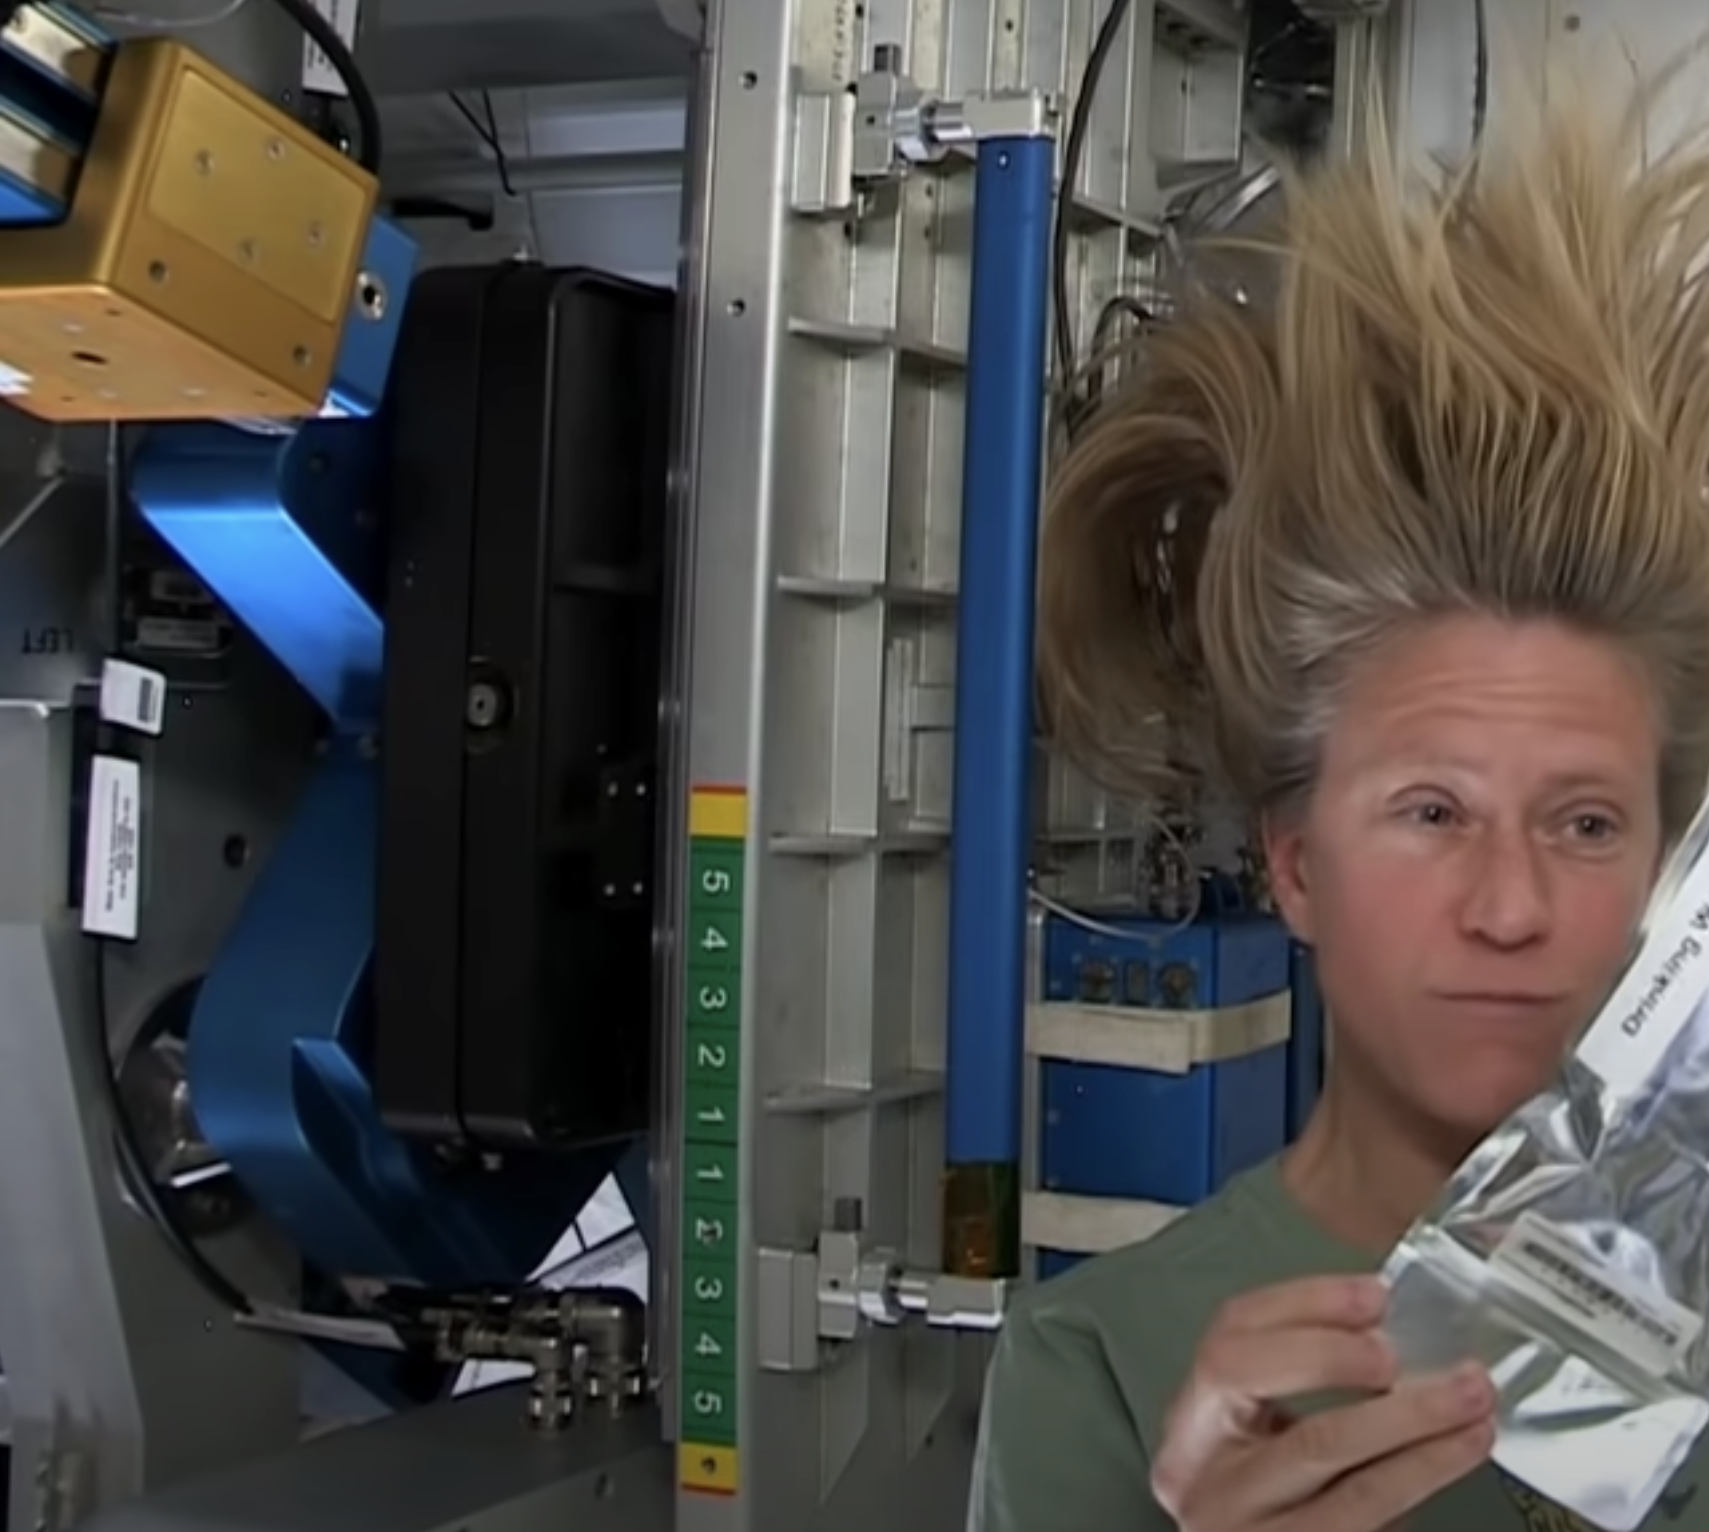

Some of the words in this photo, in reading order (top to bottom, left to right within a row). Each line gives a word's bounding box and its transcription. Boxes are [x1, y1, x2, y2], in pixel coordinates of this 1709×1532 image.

[21, 626, 74, 655] LEFT
[702, 868, 730, 893] 5
[700, 927, 728, 951] 4
[699, 986, 728, 1010] 3
[1621, 935, 1703, 1037] Drinking
[698, 1044, 726, 1069] 2
[697, 1107, 725, 1123] 1
[696, 1165, 724, 1181] 1
[695, 1218, 723, 1244] 2
[694, 1276, 723, 1300] 3
[694, 1331, 722, 1356] 4
[693, 1390, 722, 1415] 5
